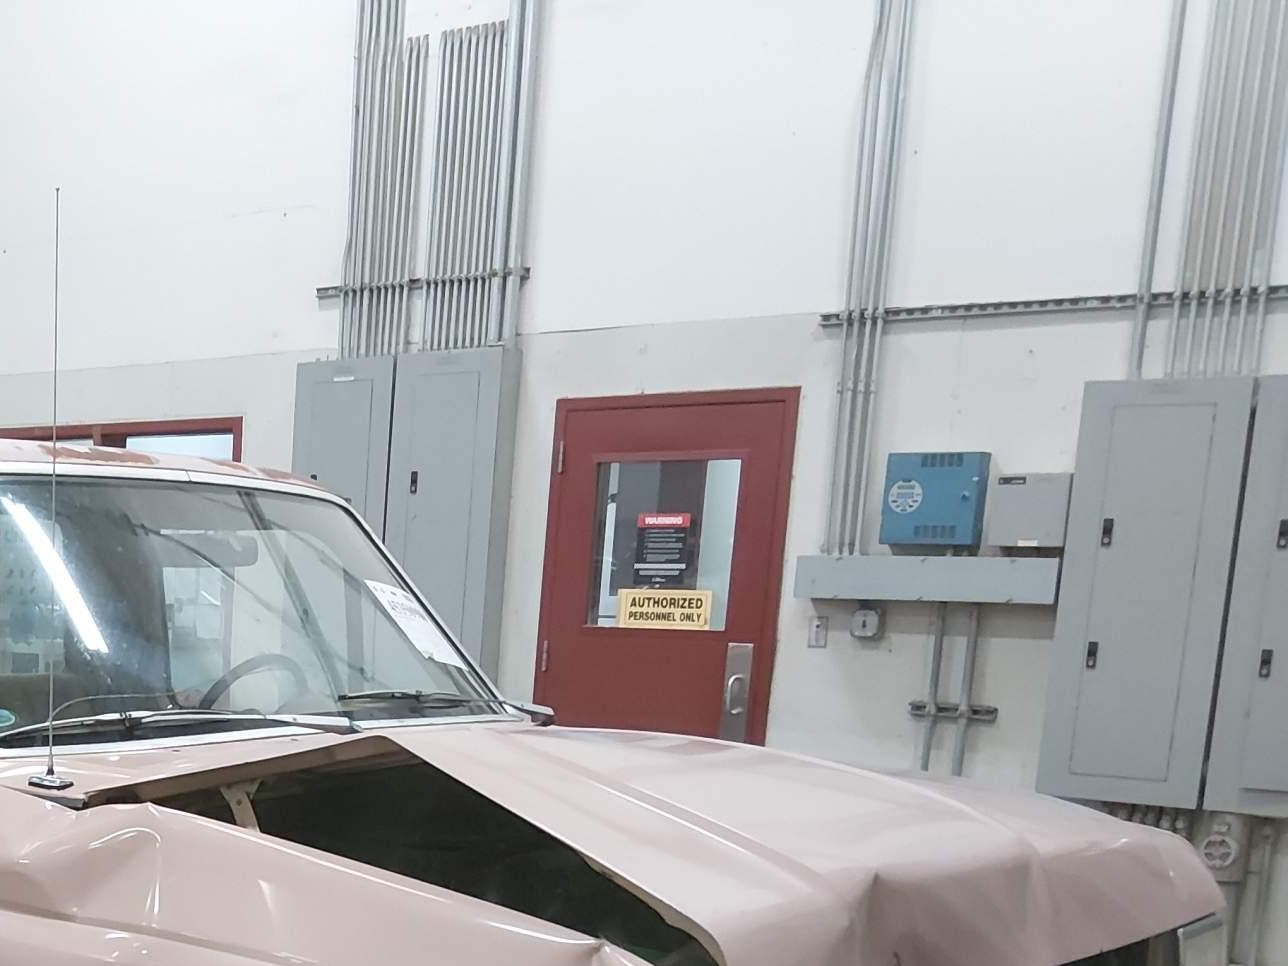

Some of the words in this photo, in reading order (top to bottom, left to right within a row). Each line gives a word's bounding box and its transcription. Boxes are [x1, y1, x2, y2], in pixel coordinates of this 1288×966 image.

[630, 596, 703, 609] AUTHORIZED
[628, 611, 676, 622] PERSONNEL
[679, 612, 702, 623] ONLY
